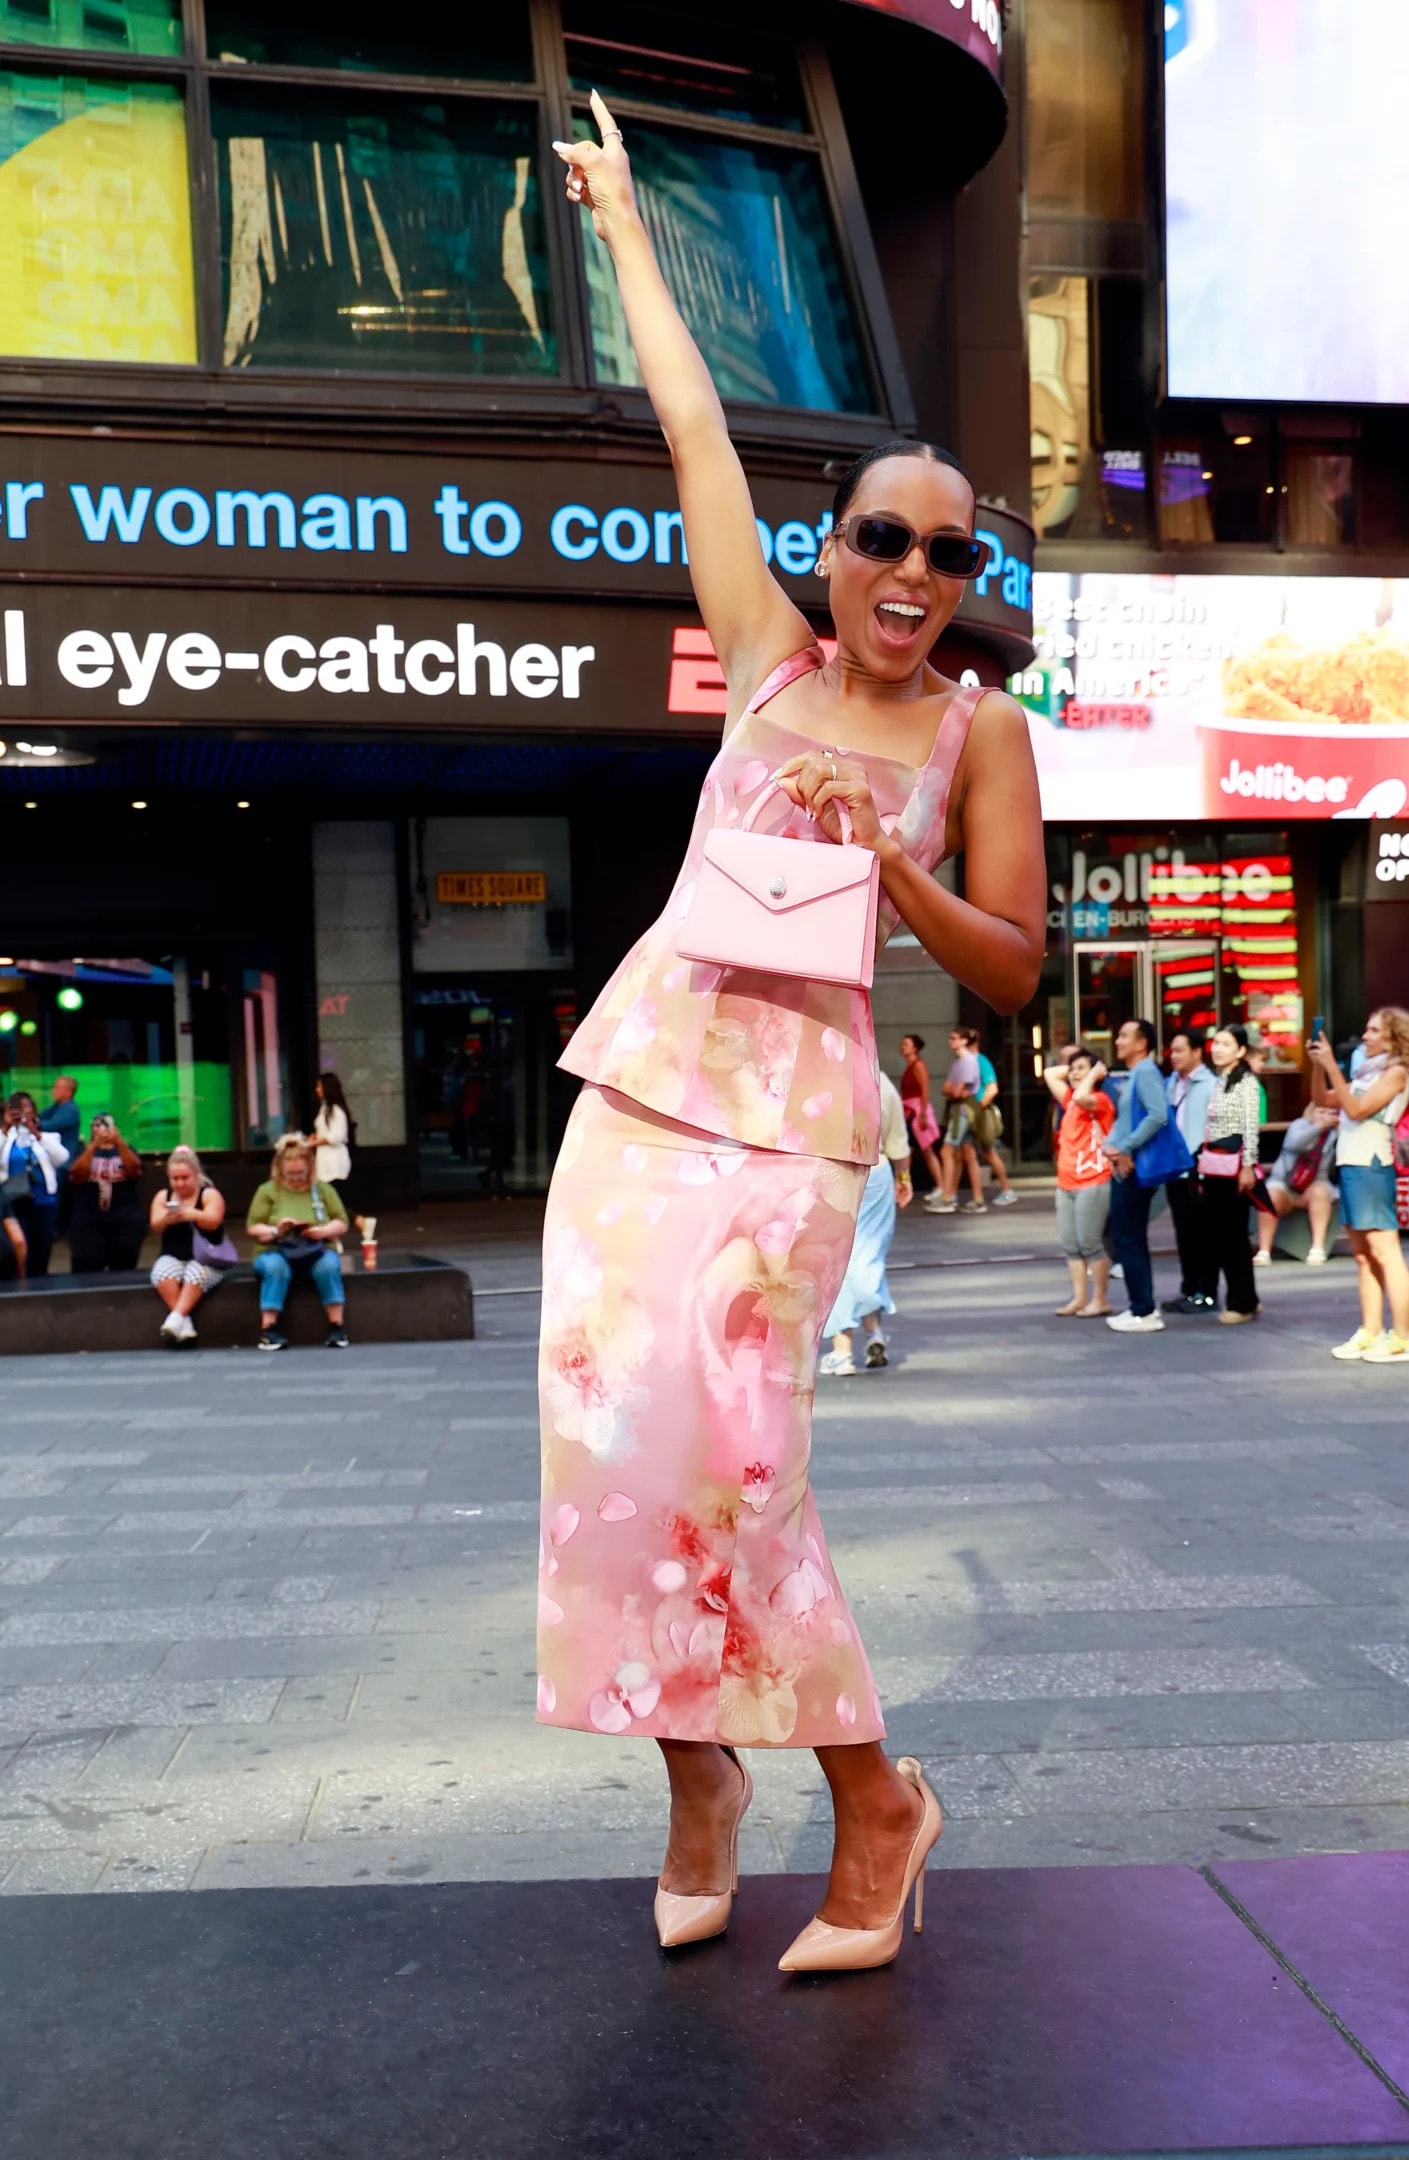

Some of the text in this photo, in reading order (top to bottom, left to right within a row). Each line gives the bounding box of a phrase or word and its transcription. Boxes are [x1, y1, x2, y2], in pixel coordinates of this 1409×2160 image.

[36, 171, 176, 224] GMA
[37, 227, 180, 276] GMA
[38, 280, 182, 329] GMA
[69, 484, 408, 553] woman
[434, 484, 522, 558] to
[57, 622, 595, 706] eye-catcher
[1220, 758, 1348, 803] Jollibee
[442, 875, 542, 897] TIMES SQUARE
